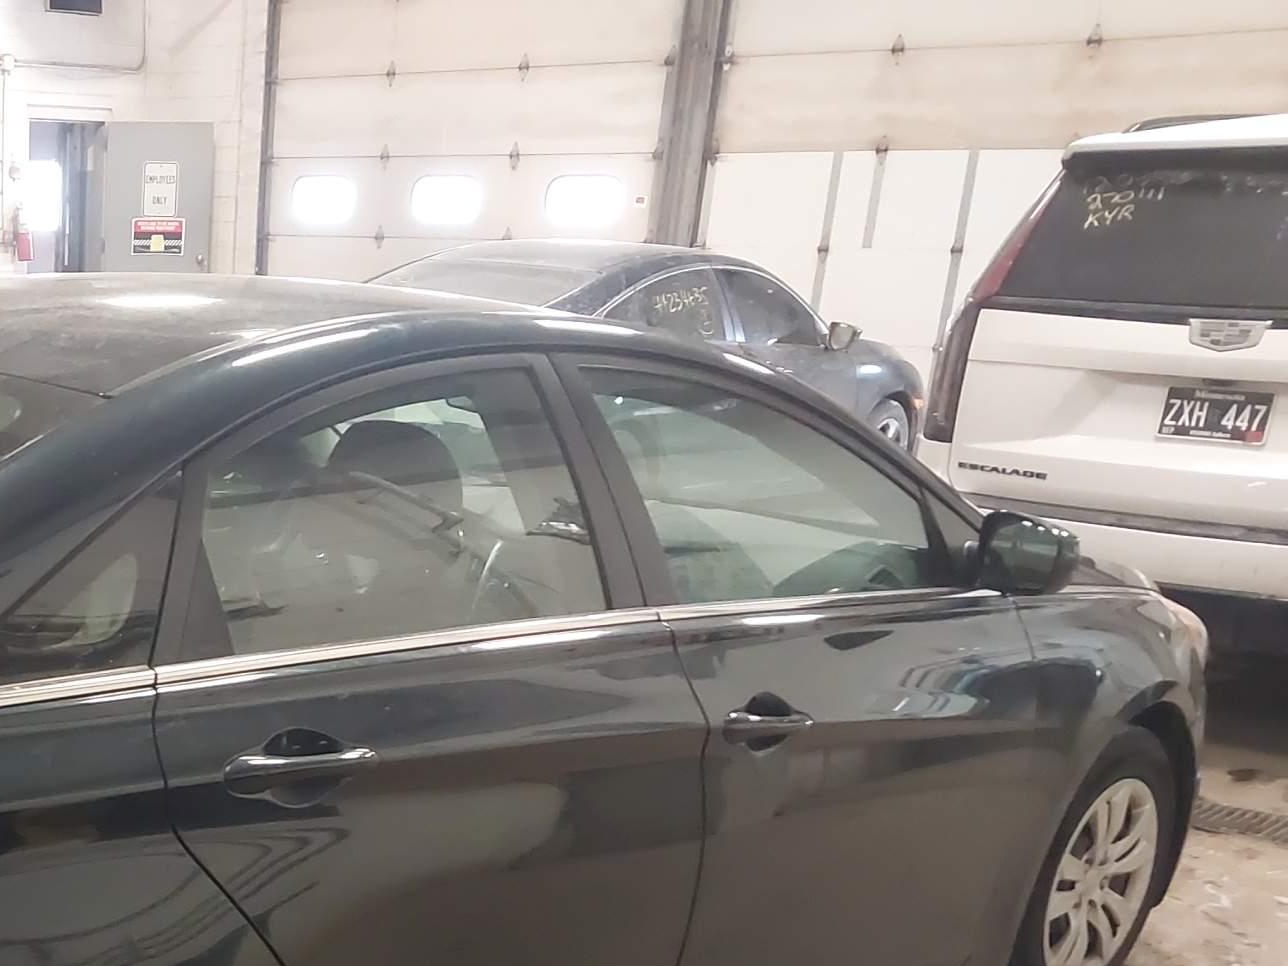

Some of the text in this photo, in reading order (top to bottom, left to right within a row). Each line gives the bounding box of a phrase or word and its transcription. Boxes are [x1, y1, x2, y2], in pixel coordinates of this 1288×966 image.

[145, 175, 176, 184] EMPLOYEES
[152, 195, 168, 206] ONLY
[1163, 398, 1269, 432] ZXH 447
[958, 461, 1049, 481] ESCALADE
